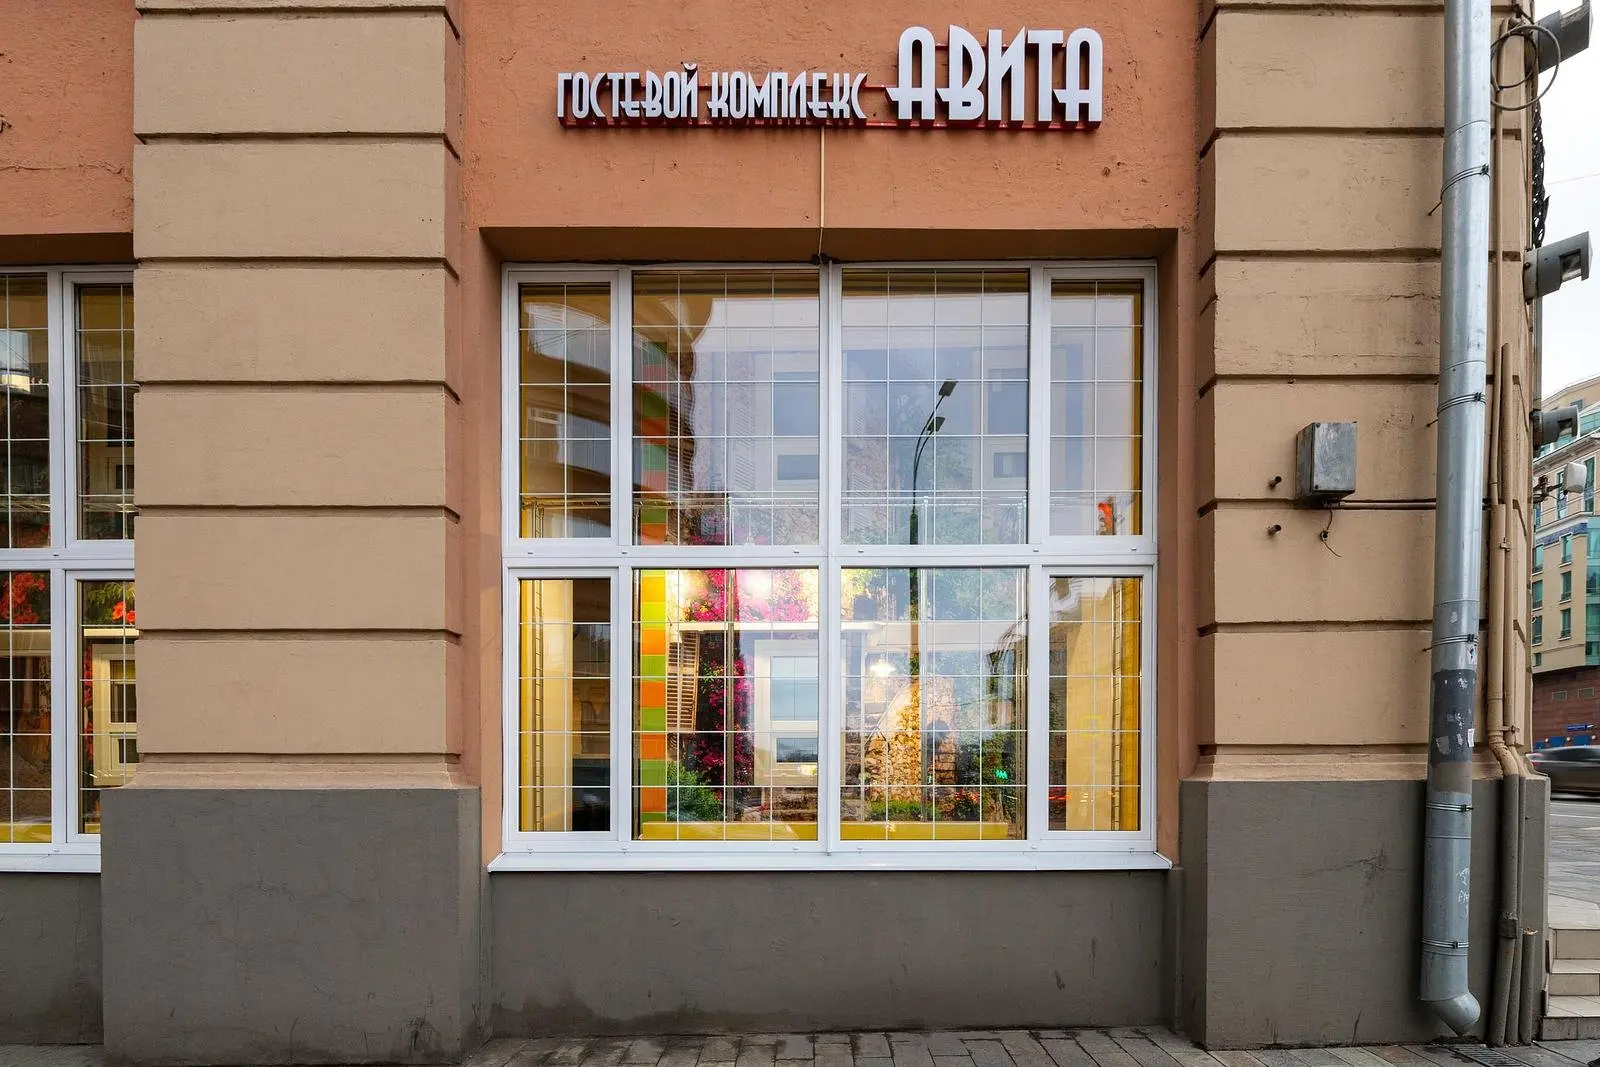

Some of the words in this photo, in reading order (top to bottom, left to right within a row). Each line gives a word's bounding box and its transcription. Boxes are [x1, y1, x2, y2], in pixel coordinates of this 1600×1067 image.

[557, 63, 698, 118] ГОСТЕВОЙ
[706, 71, 868, 118] КОМПЛЕКС
[885, 24, 1104, 121] АВИТА
